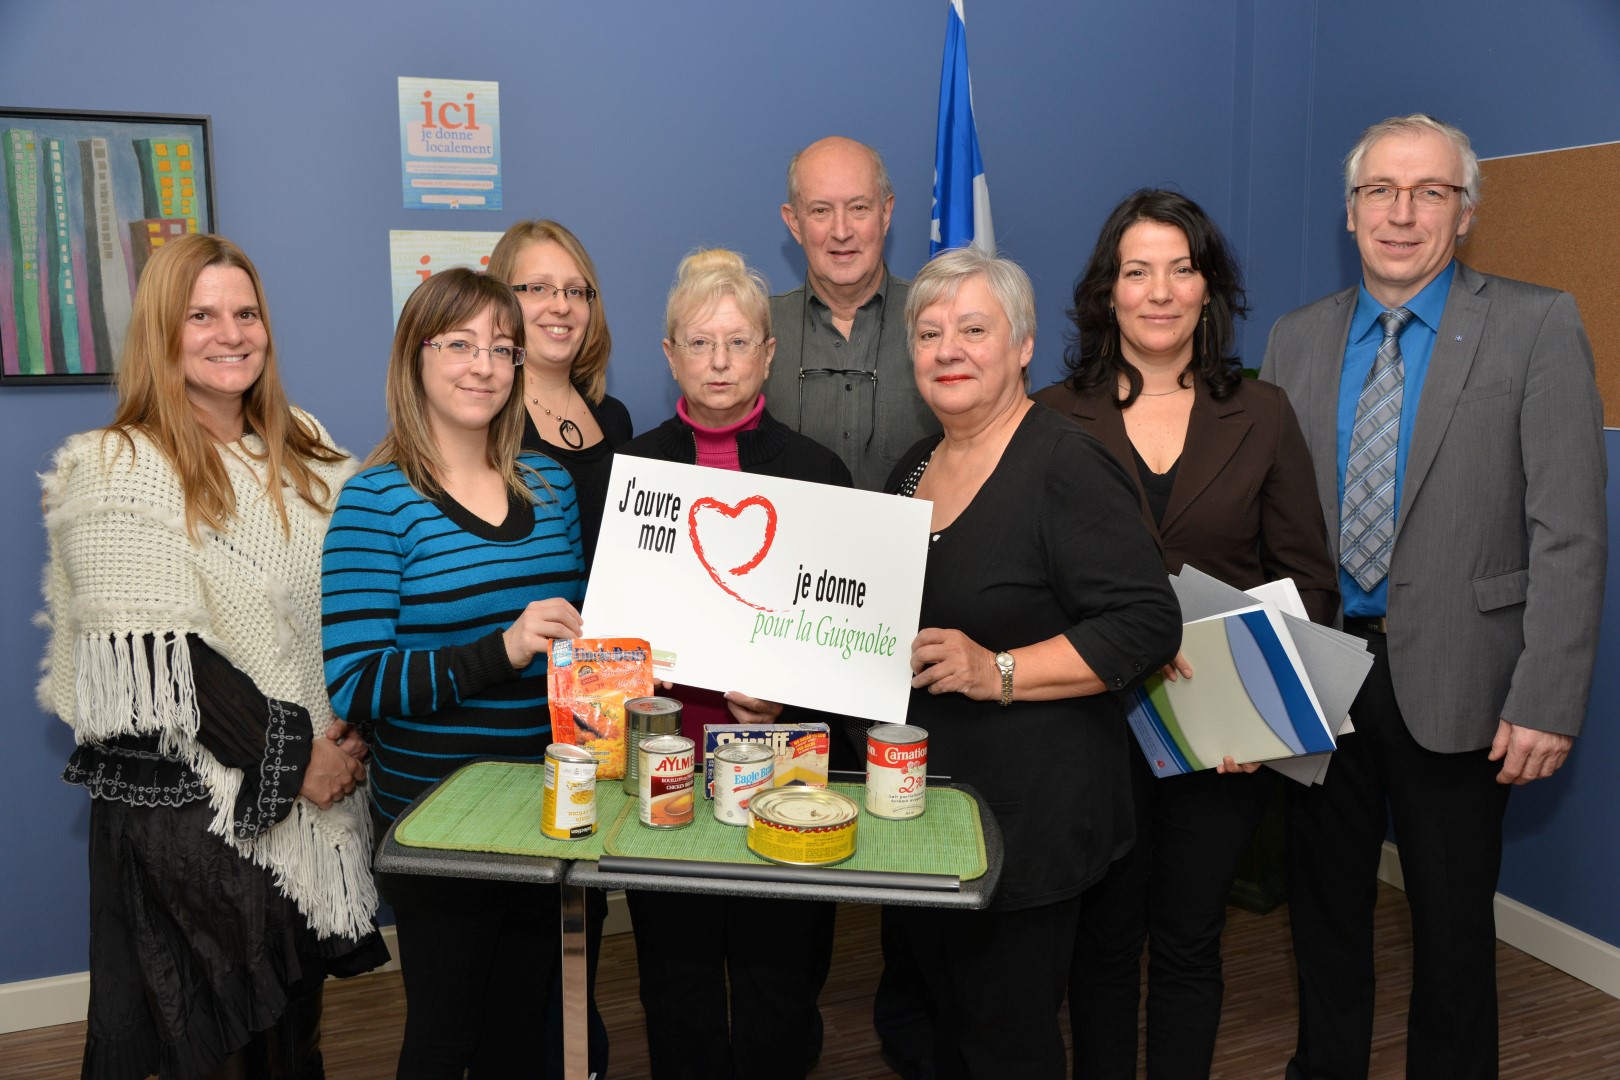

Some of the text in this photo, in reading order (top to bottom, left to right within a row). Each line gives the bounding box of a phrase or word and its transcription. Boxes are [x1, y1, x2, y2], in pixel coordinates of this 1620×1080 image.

[421, 90, 480, 130] ici
[422, 128, 473, 142] je donne
[426, 140, 491, 154] localement
[618, 476, 681, 522] J'ouvre
[638, 523, 677, 554] mon
[793, 564, 866, 608] je donne
[750, 609, 897, 660] pour la Guignolée
[574, 647, 611, 662] Uncle
[613, 646, 646, 661] Ben's
[655, 755, 694, 772] AYLME
[734, 771, 759, 785] Eagle
[898, 774, 924, 793] 2%
